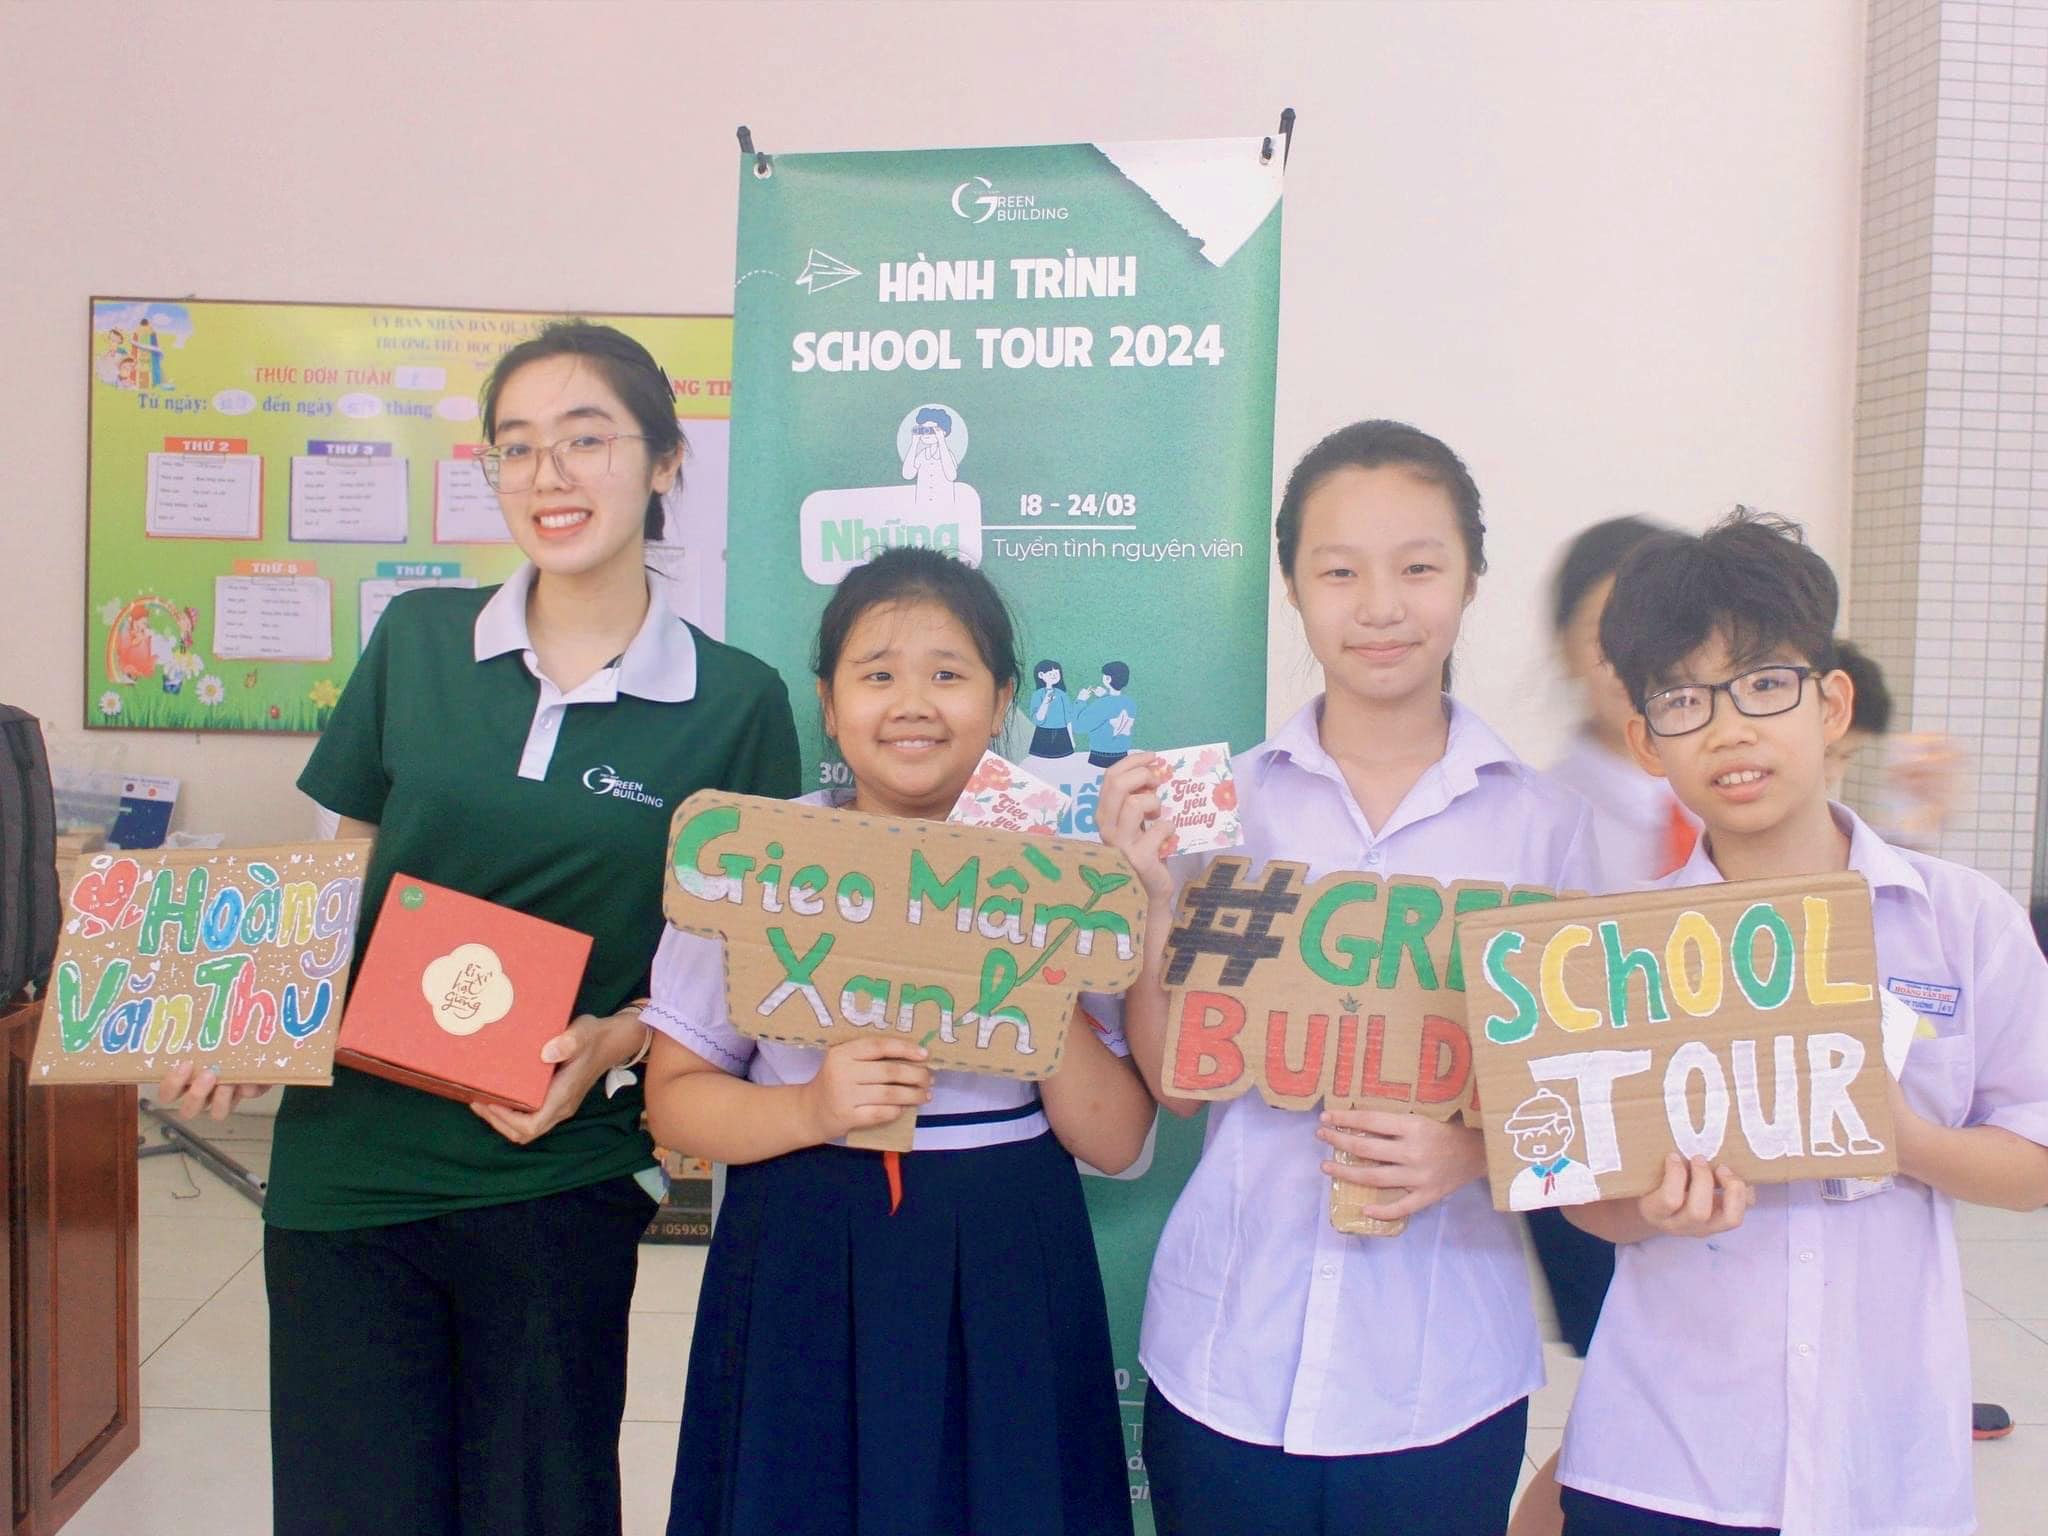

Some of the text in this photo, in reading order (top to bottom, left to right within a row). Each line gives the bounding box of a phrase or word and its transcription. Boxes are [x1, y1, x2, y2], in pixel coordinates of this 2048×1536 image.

[997, 208, 1069, 221] BUILDING
[879, 249, 1137, 302] HÀNH TRÌNH
[792, 324, 1225, 372] SCHOOL TOUR 2024
[218, 441, 230, 452] 2
[1020, 494, 1043, 516] 18
[1067, 491, 1137, 518] 24/03
[992, 536, 1244, 562] Tuyển tình nguyện viên
[612, 788, 664, 808] BUILDING
[991, 793, 1029, 820] Gieo
[1171, 778, 1206, 802] Gieo
[1181, 794, 1208, 815] yêu
[672, 805, 1137, 961] Gieo Mầm
[137, 862, 363, 981] Hoàng
[57, 952, 333, 1054] Văn Thụ
[756, 926, 1038, 1056] Xanh
[1172, 991, 1481, 1113] BUILD
[1527, 1032, 1886, 1176] TOUR
